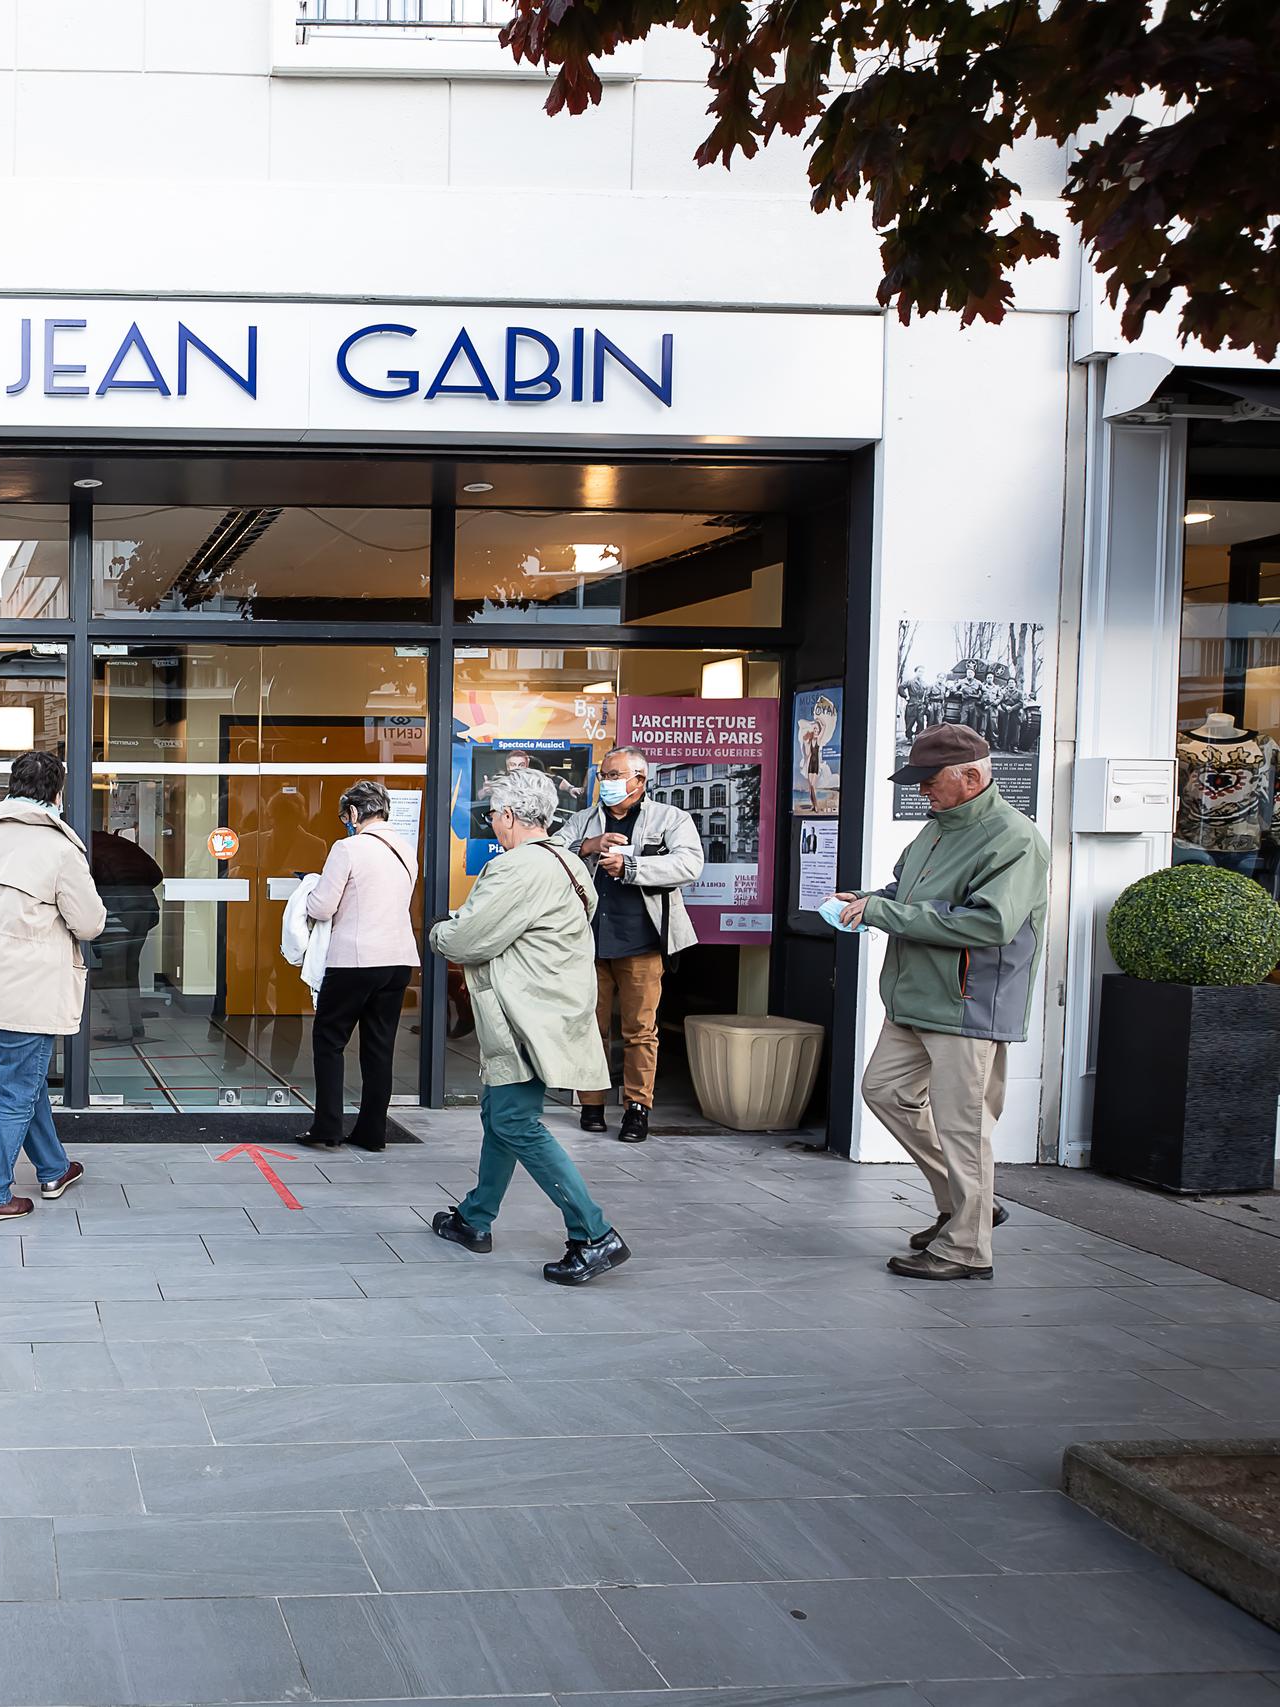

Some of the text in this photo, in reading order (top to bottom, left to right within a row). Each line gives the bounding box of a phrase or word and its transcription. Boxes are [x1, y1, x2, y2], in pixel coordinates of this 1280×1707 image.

[6, 318, 260, 401] JEAN
[336, 322, 675, 409] GABIN
[631, 729, 763, 745] MODERNE À PARIS
[499, 741, 534, 749] Spectacle
[642, 747, 763, 757] TRE LES DEUX GUERRES
[489, 844, 505, 853] Pia
